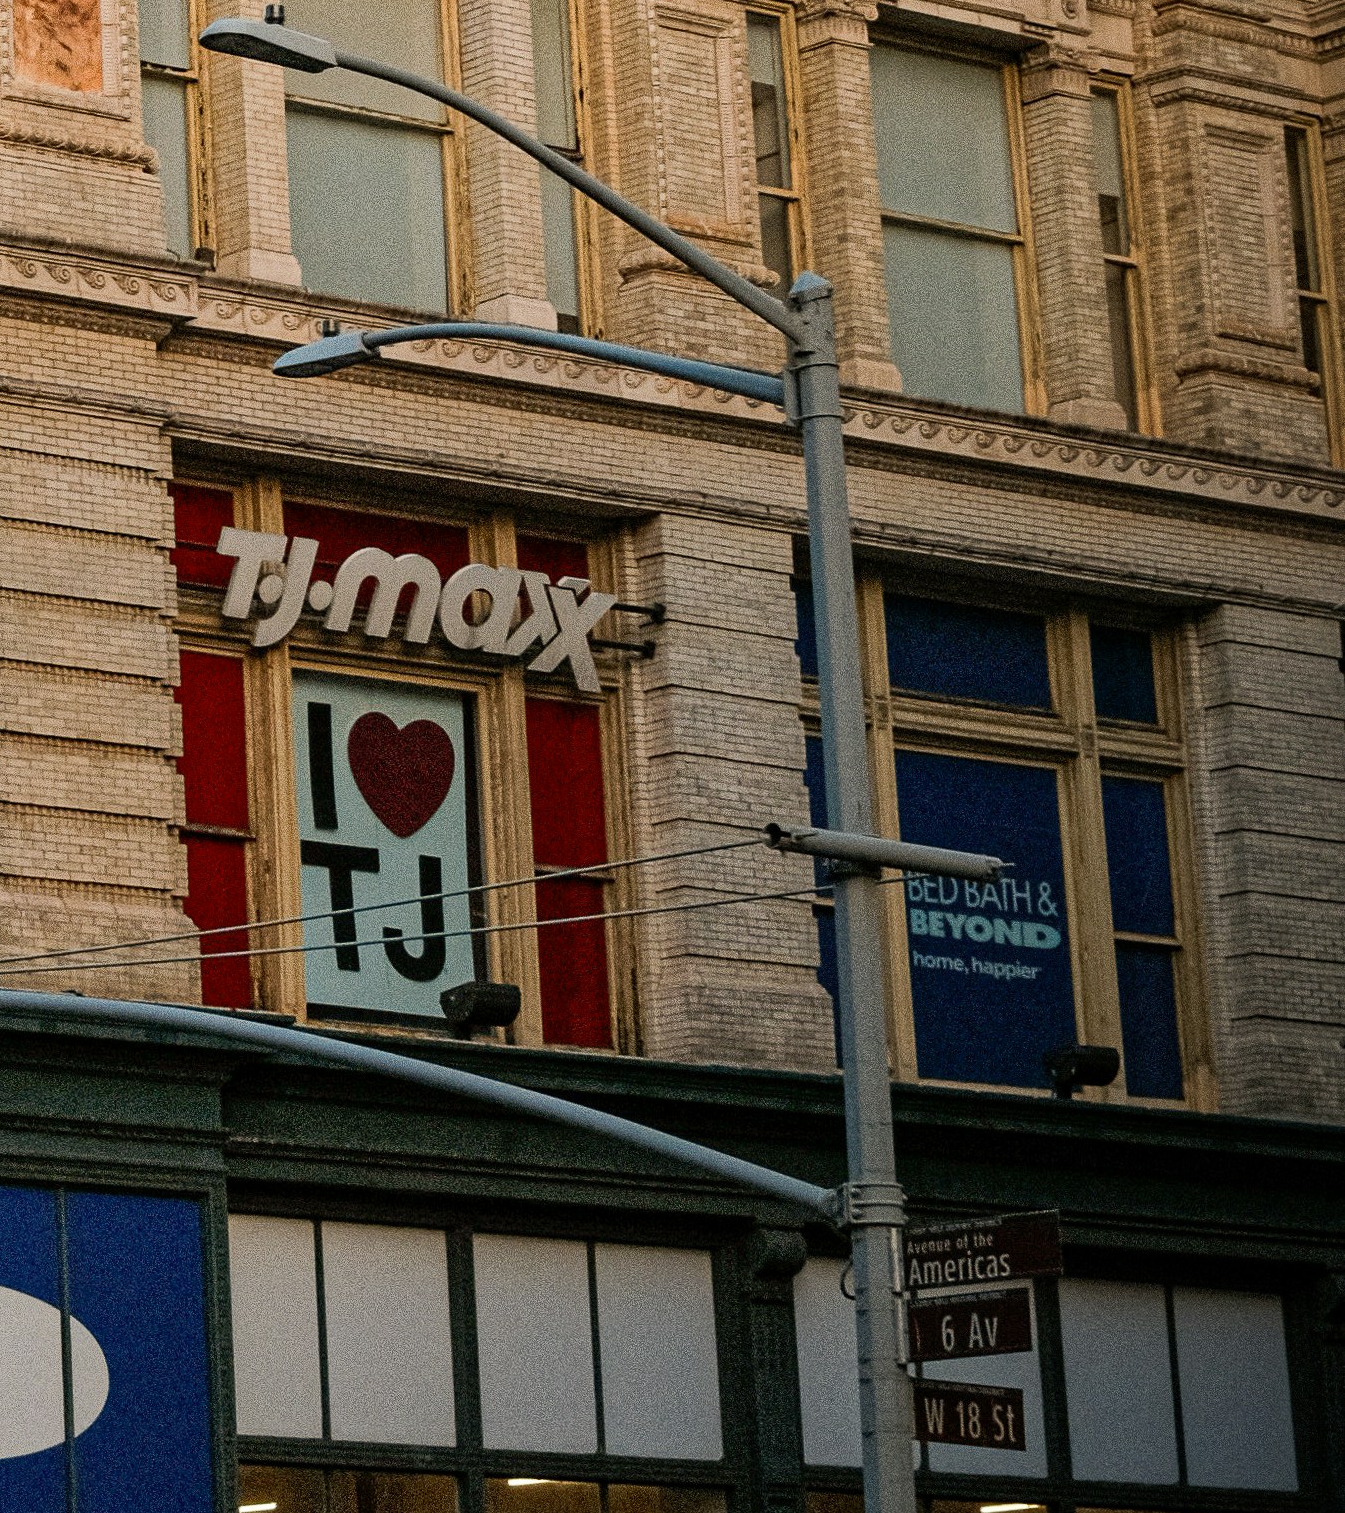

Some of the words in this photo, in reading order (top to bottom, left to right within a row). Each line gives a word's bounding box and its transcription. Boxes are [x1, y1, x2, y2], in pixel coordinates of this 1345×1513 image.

[307, 701, 338, 832] I
[300, 840, 447, 983] TJ
[907, 872, 959, 906] BED
[964, 877, 1033, 914] BATH
[1037, 881, 1059, 917] &
[910, 908, 1062, 950] BEYOND
[912, 950, 970, 975] home,
[971, 957, 1038, 981] happier
[907, 1239, 951, 1255] Avenue
[955, 1233, 969, 1250] of
[972, 1231, 994, 1248] the
[908, 1250, 1012, 1286] Americas
[940, 1314, 955, 1352] 6
[968, 1312, 999, 1349] Av
[923, 1396, 945, 1435] W
[956, 1400, 982, 1439] 18
[992, 1403, 1016, 1443] St
